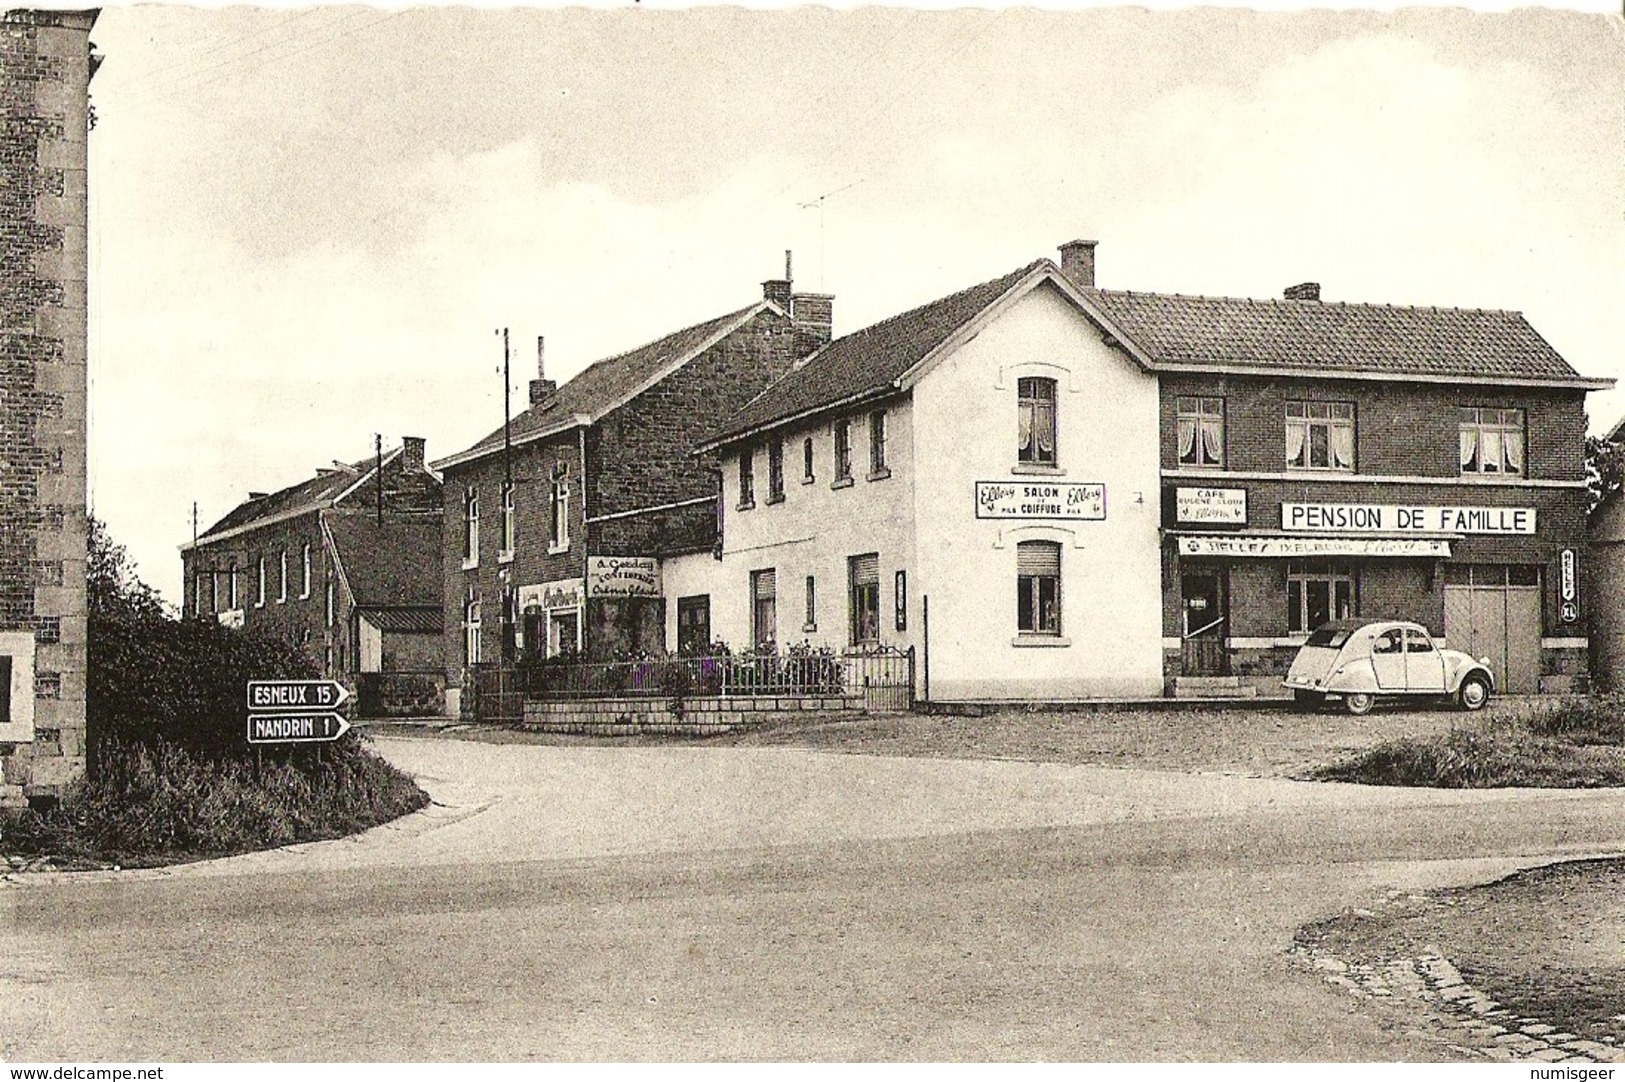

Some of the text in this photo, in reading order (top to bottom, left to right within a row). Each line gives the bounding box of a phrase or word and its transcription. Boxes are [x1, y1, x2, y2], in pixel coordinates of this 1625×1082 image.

[1024, 487, 1059, 497] SALON
[1021, 504, 1062, 514] COIFFURE
[1292, 507, 1527, 531] PENSION DE FAMILLE
[254, 686, 331, 704] ESNEUX 15
[256, 718, 330, 737] NANDRIN 1
